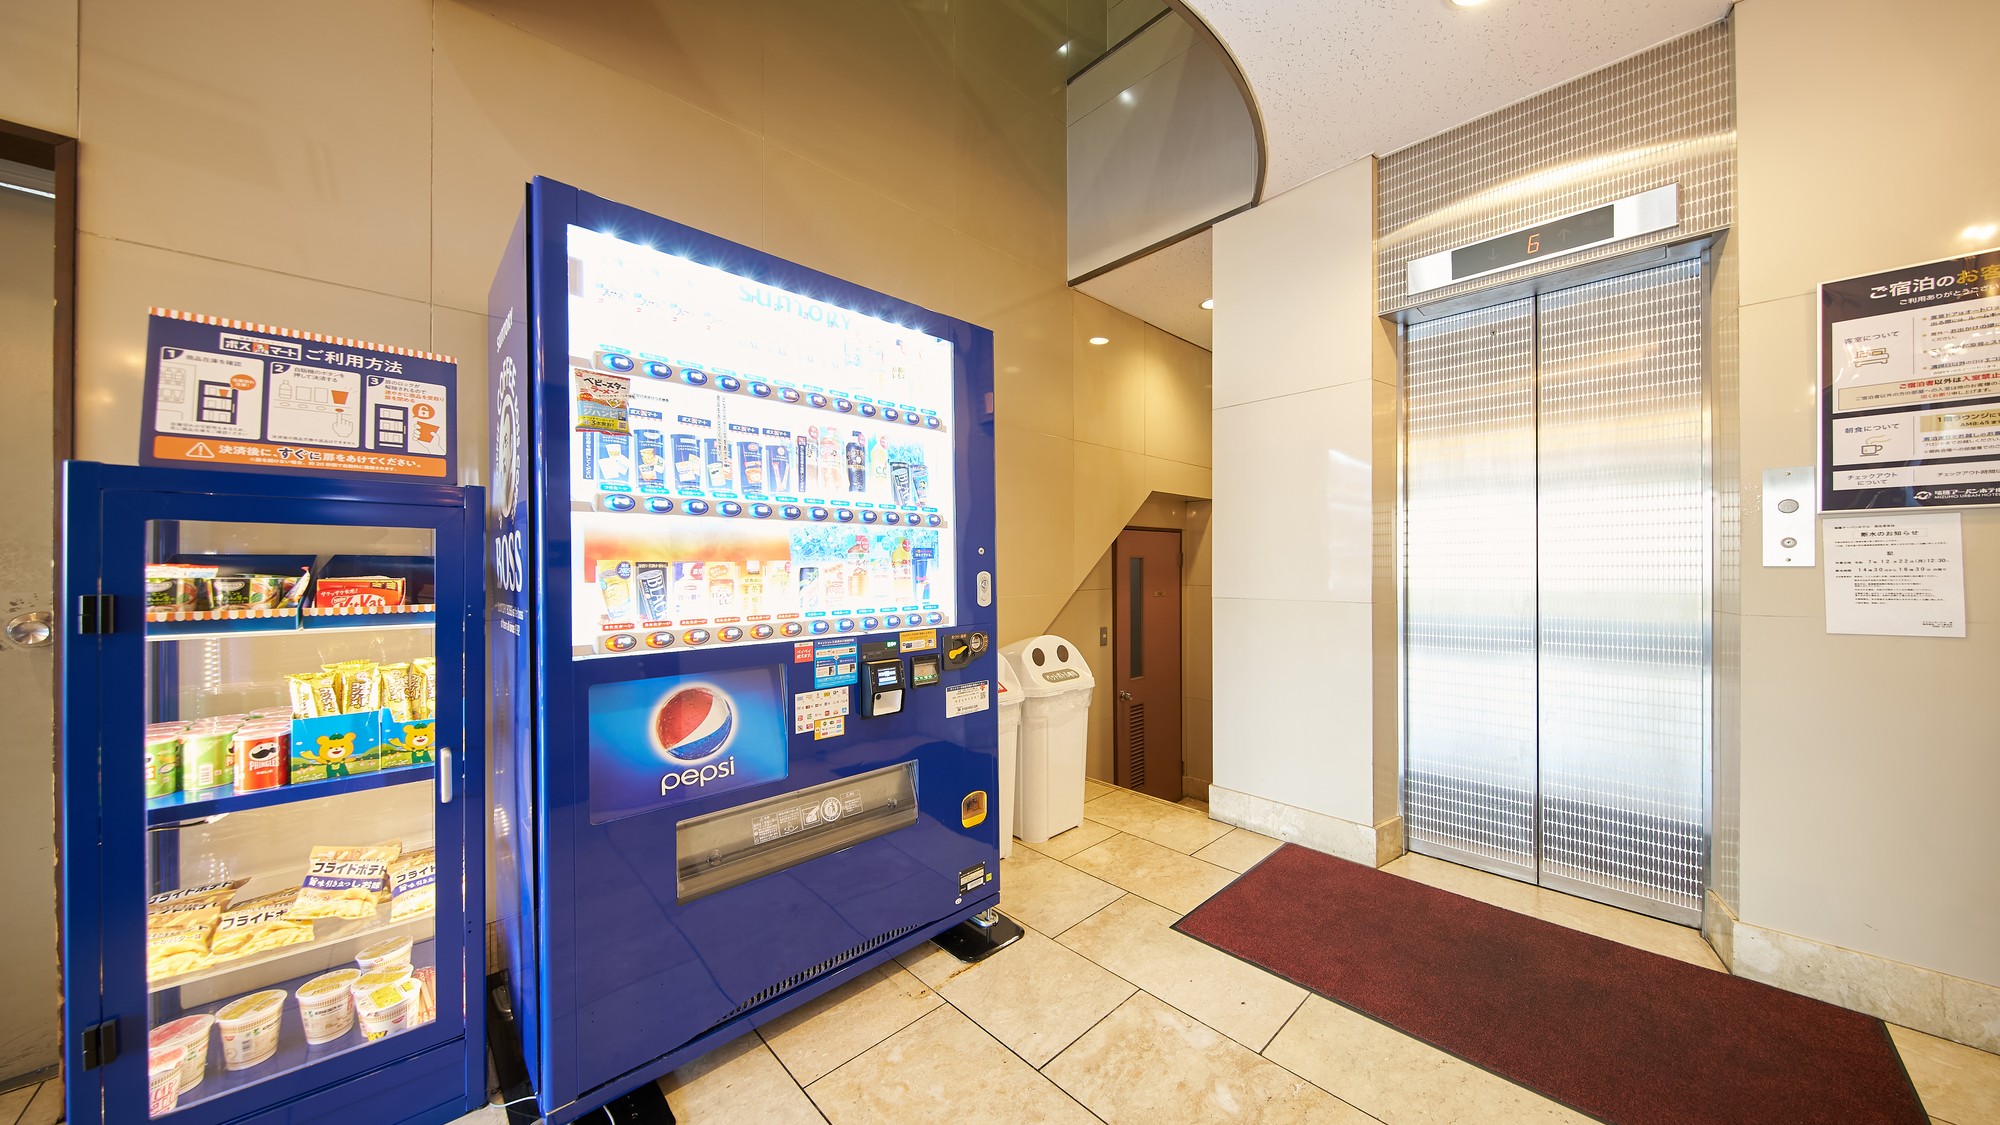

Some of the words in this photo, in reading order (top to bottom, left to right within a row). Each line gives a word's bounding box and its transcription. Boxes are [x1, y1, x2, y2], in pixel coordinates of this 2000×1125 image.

[1526, 233, 1540, 254] 6
[738, 284, 852, 330] SUNTORY
[1844, 331, 1900, 344] 客室について
[166, 350, 175, 358] 1
[274, 364, 284, 372] 2
[305, 349, 403, 375] ご利用方法
[370, 377, 379, 385] 3
[583, 377, 627, 391] ベビースター
[590, 385, 619, 395] ラーメン
[1845, 423, 1900, 433] 朝食について
[1847, 472, 1898, 480] チェックアウト
[495, 530, 523, 593] BOSS
[249, 757, 280, 771] PRINGLES
[661, 756, 735, 796] pepsi
